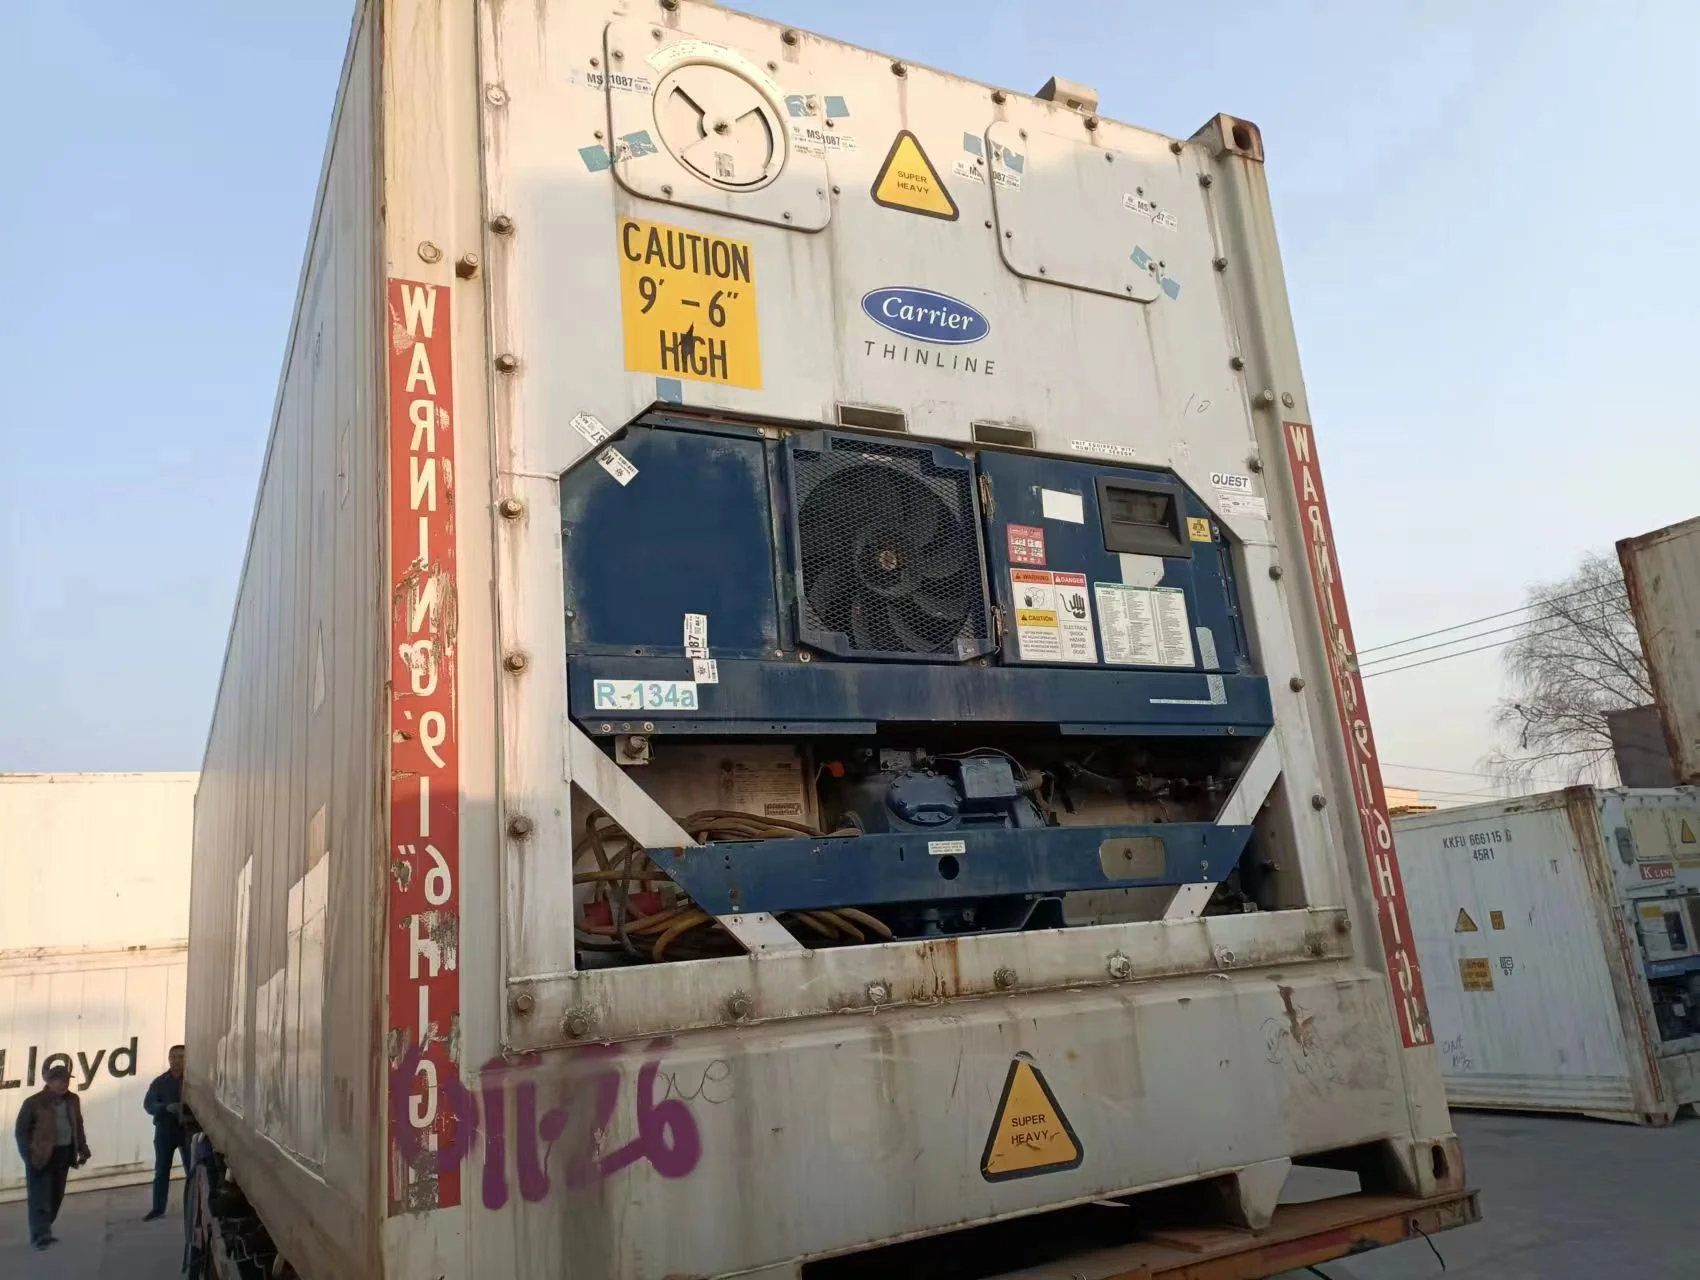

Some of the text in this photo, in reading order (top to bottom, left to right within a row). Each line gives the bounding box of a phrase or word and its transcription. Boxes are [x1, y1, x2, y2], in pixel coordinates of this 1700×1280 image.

[897, 170, 927, 183] SUPER
[897, 181, 929, 194] HEAVY
[622, 222, 751, 283] CAUTION
[882, 297, 974, 330] Carrier
[659, 330, 728, 379] HIGH
[864, 340, 995, 375] THINLINE
[1212, 474, 1249, 488] QUEST
[1022, 573, 1050, 582] WARNING
[1027, 614, 1054, 622] CAUTION
[1442, 836, 1467, 849] KKFU
[1469, 830, 1502, 846] 666115
[1473, 848, 1495, 861] 45R1
[1643, 865, 1653, 878] K
[0, 1036, 138, 1091] Lloyd
[1011, 1114, 1046, 1127] SUPER
[1011, 1130, 1049, 1145] HEAVY
